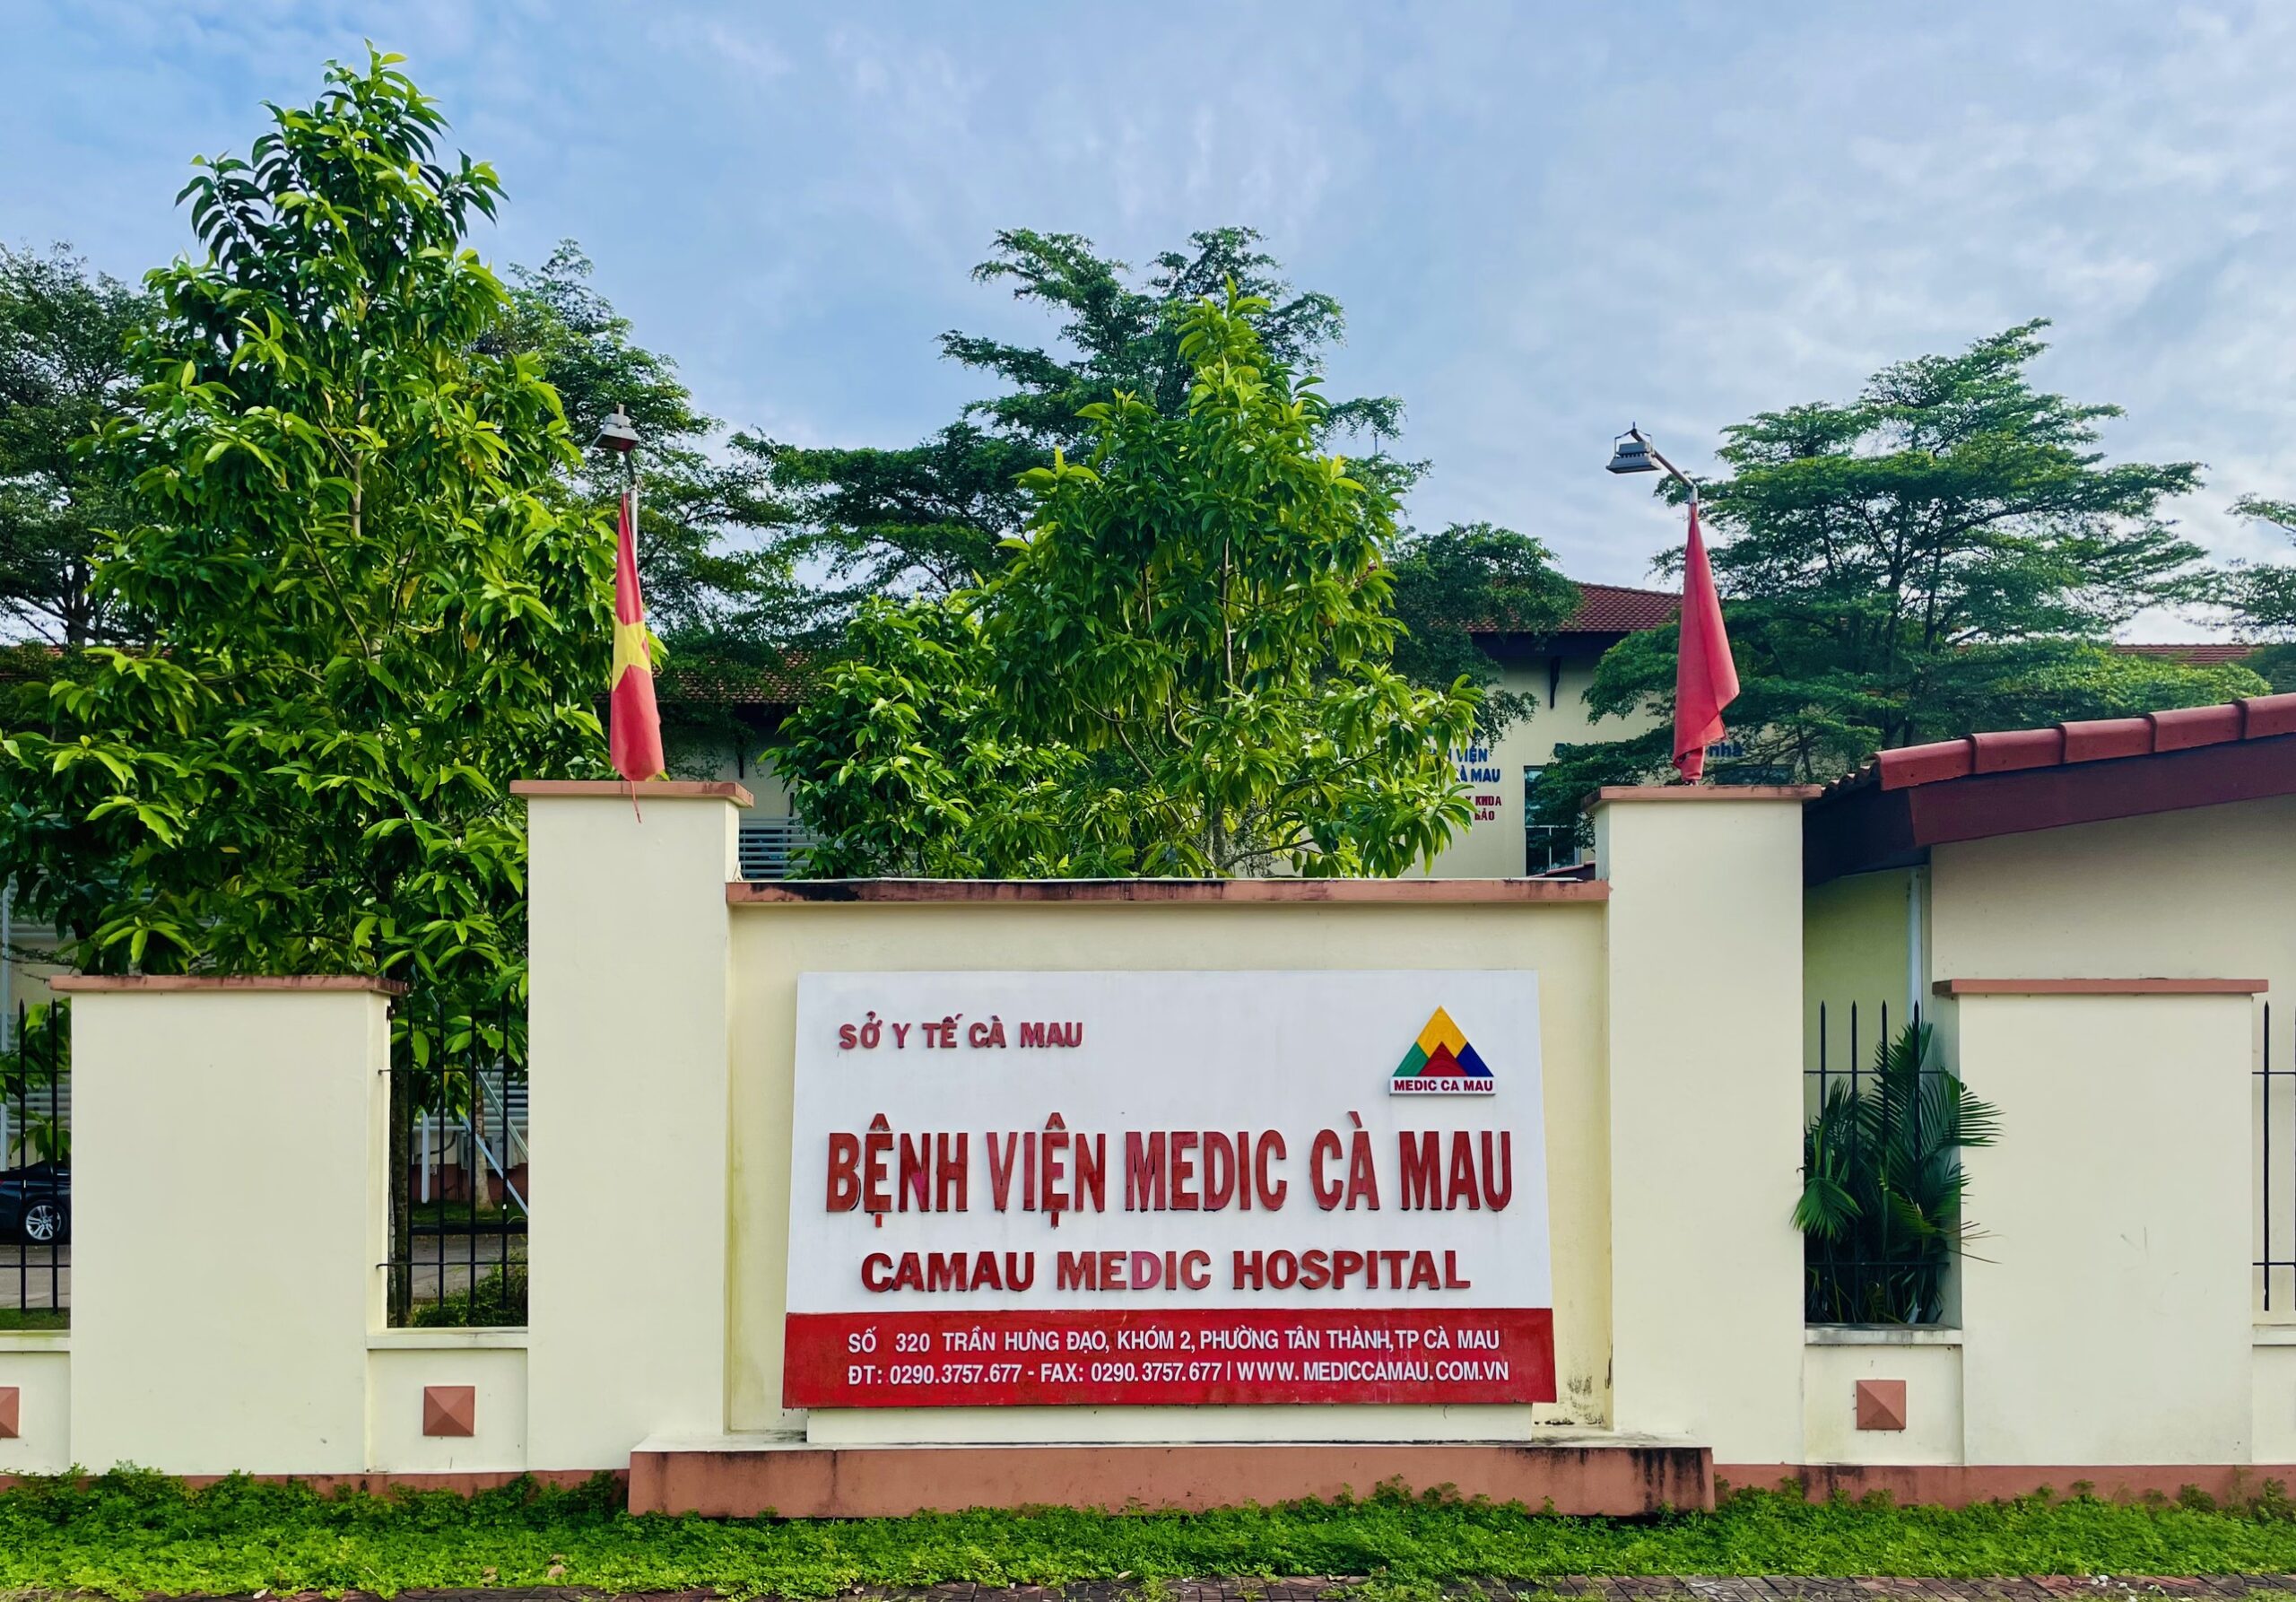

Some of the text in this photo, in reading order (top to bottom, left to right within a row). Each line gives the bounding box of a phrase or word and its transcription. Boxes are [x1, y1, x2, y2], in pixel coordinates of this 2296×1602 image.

[1471, 768, 1500, 782] MAU
[1474, 796, 1502, 806] KHOA
[839, 1011, 1083, 1049] SỞ Y TẾ CÀ MAU
[1394, 1080, 1493, 1092] MEDIC CA MAU
[826, 1110, 1513, 1229] BỆNH VIỆN MEDIC CÀ MAU
[861, 1249, 1472, 1293] CAMAU MEDIC HOSPITAL
[848, 1327, 878, 1354] SỐ
[895, 1333, 930, 1353] 320
[942, 1326, 996, 1352] TRẦN
[1004, 1329, 1059, 1352] HƯNG
[1065, 1330, 1110, 1354] ĐẠO,
[1118, 1325, 1174, 1351] KHÓM
[1179, 1331, 1196, 1354] 2,
[1200, 1325, 1279, 1350] PHƯỜNG
[1284, 1326, 1320, 1350] TÂN
[1422, 1325, 1450, 1350] CÀ
[1457, 1328, 1500, 1350] MAU
[848, 1365, 883, 1385] ĐT:
[890, 1363, 1022, 1385] 0290.3757.677
[1040, 1363, 1083, 1383] FAX:
